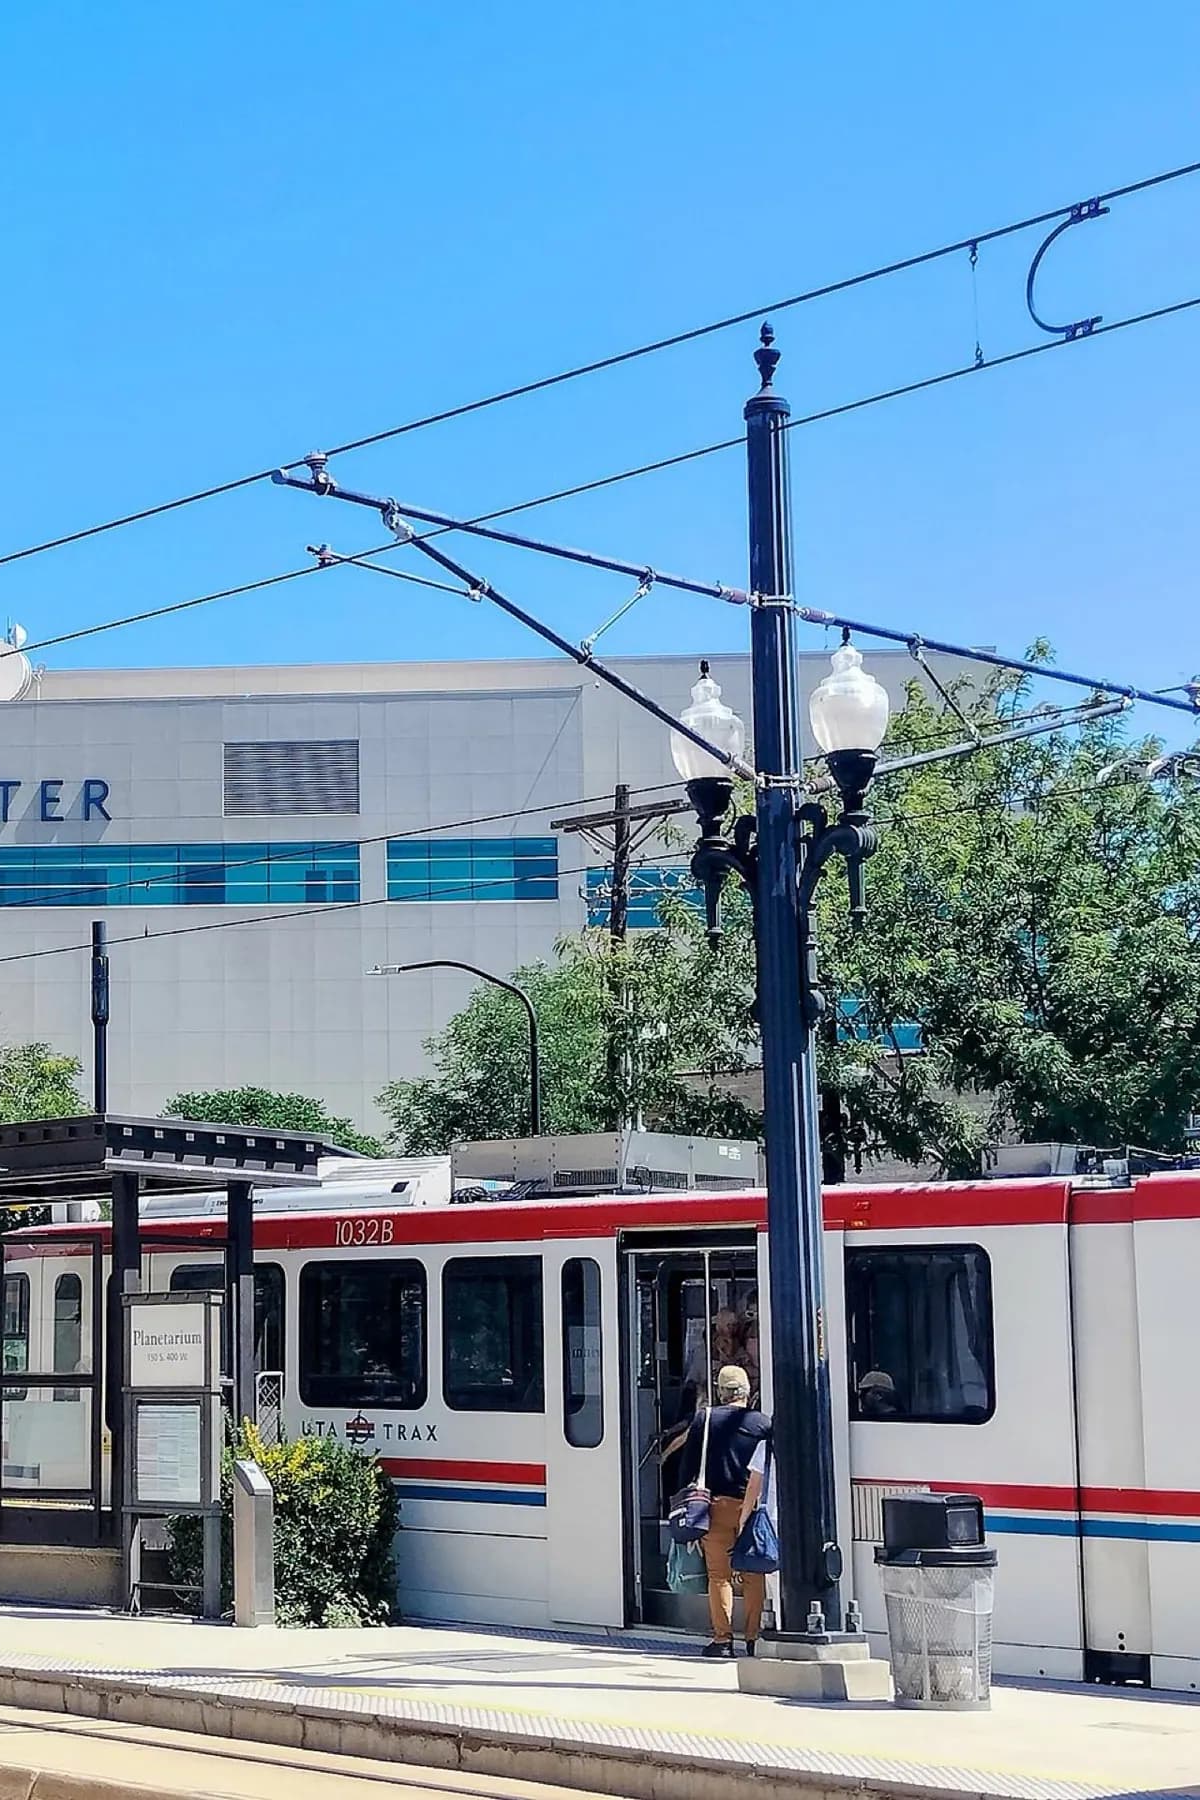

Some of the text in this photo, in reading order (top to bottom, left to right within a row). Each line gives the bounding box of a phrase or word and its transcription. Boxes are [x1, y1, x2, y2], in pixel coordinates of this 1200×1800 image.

[335, 1219, 394, 1245] 1032B
[133, 1329, 202, 1346] Planetarium
[166, 1352, 179, 1362] 400
[301, 1420, 439, 1441] UTA TRAX
